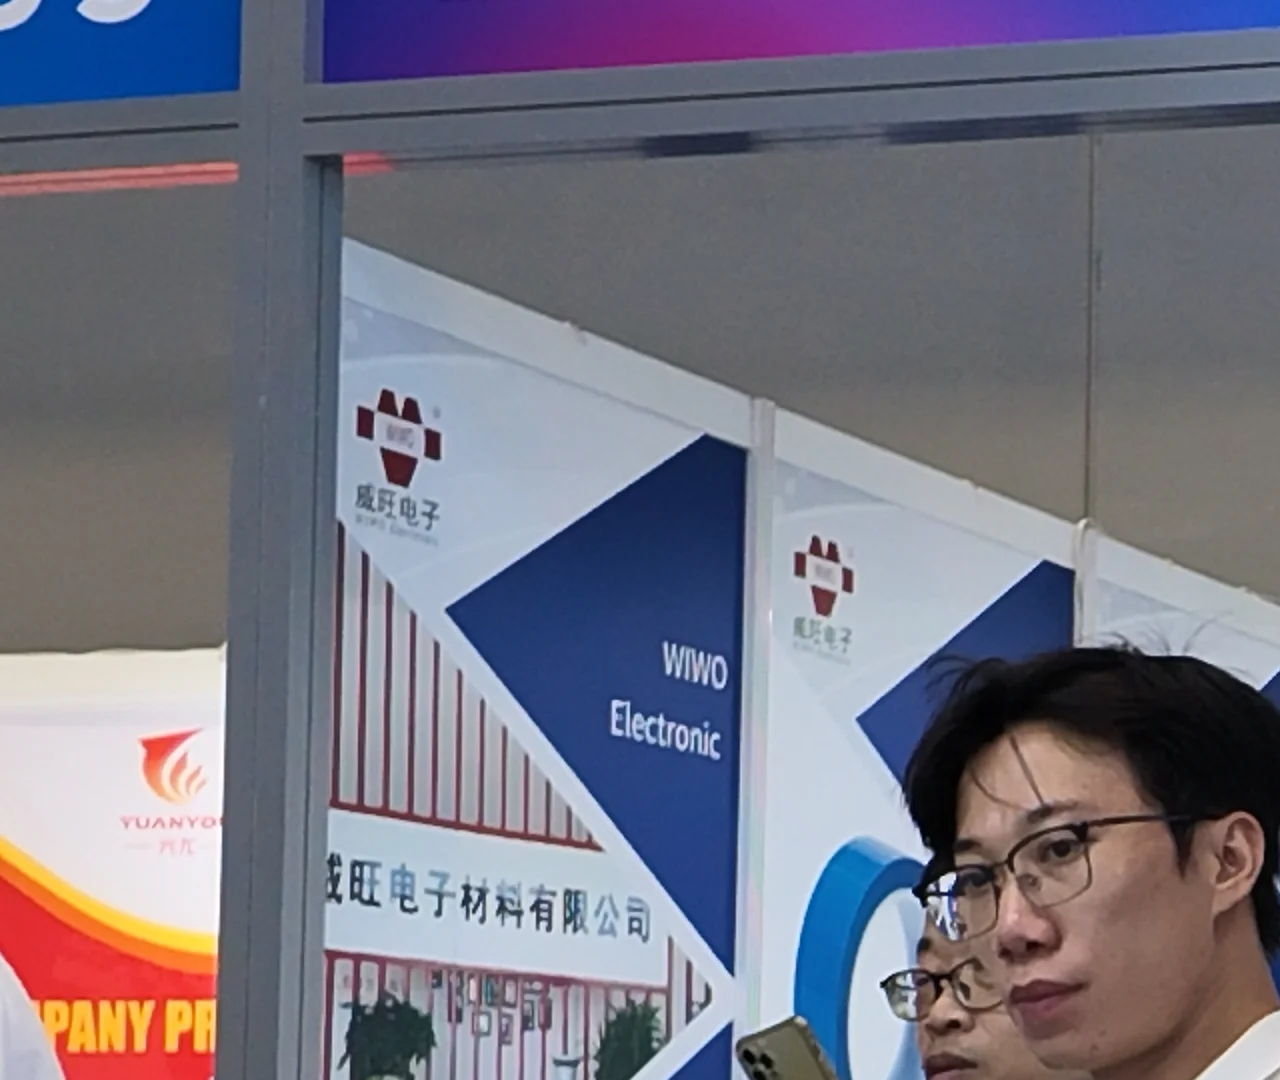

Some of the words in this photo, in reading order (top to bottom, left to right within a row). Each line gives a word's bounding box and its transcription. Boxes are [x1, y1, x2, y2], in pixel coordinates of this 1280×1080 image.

[662, 640, 728, 690] WIWO
[609, 699, 722, 761] Electronic
[38, 999, 156, 1054] PANY
